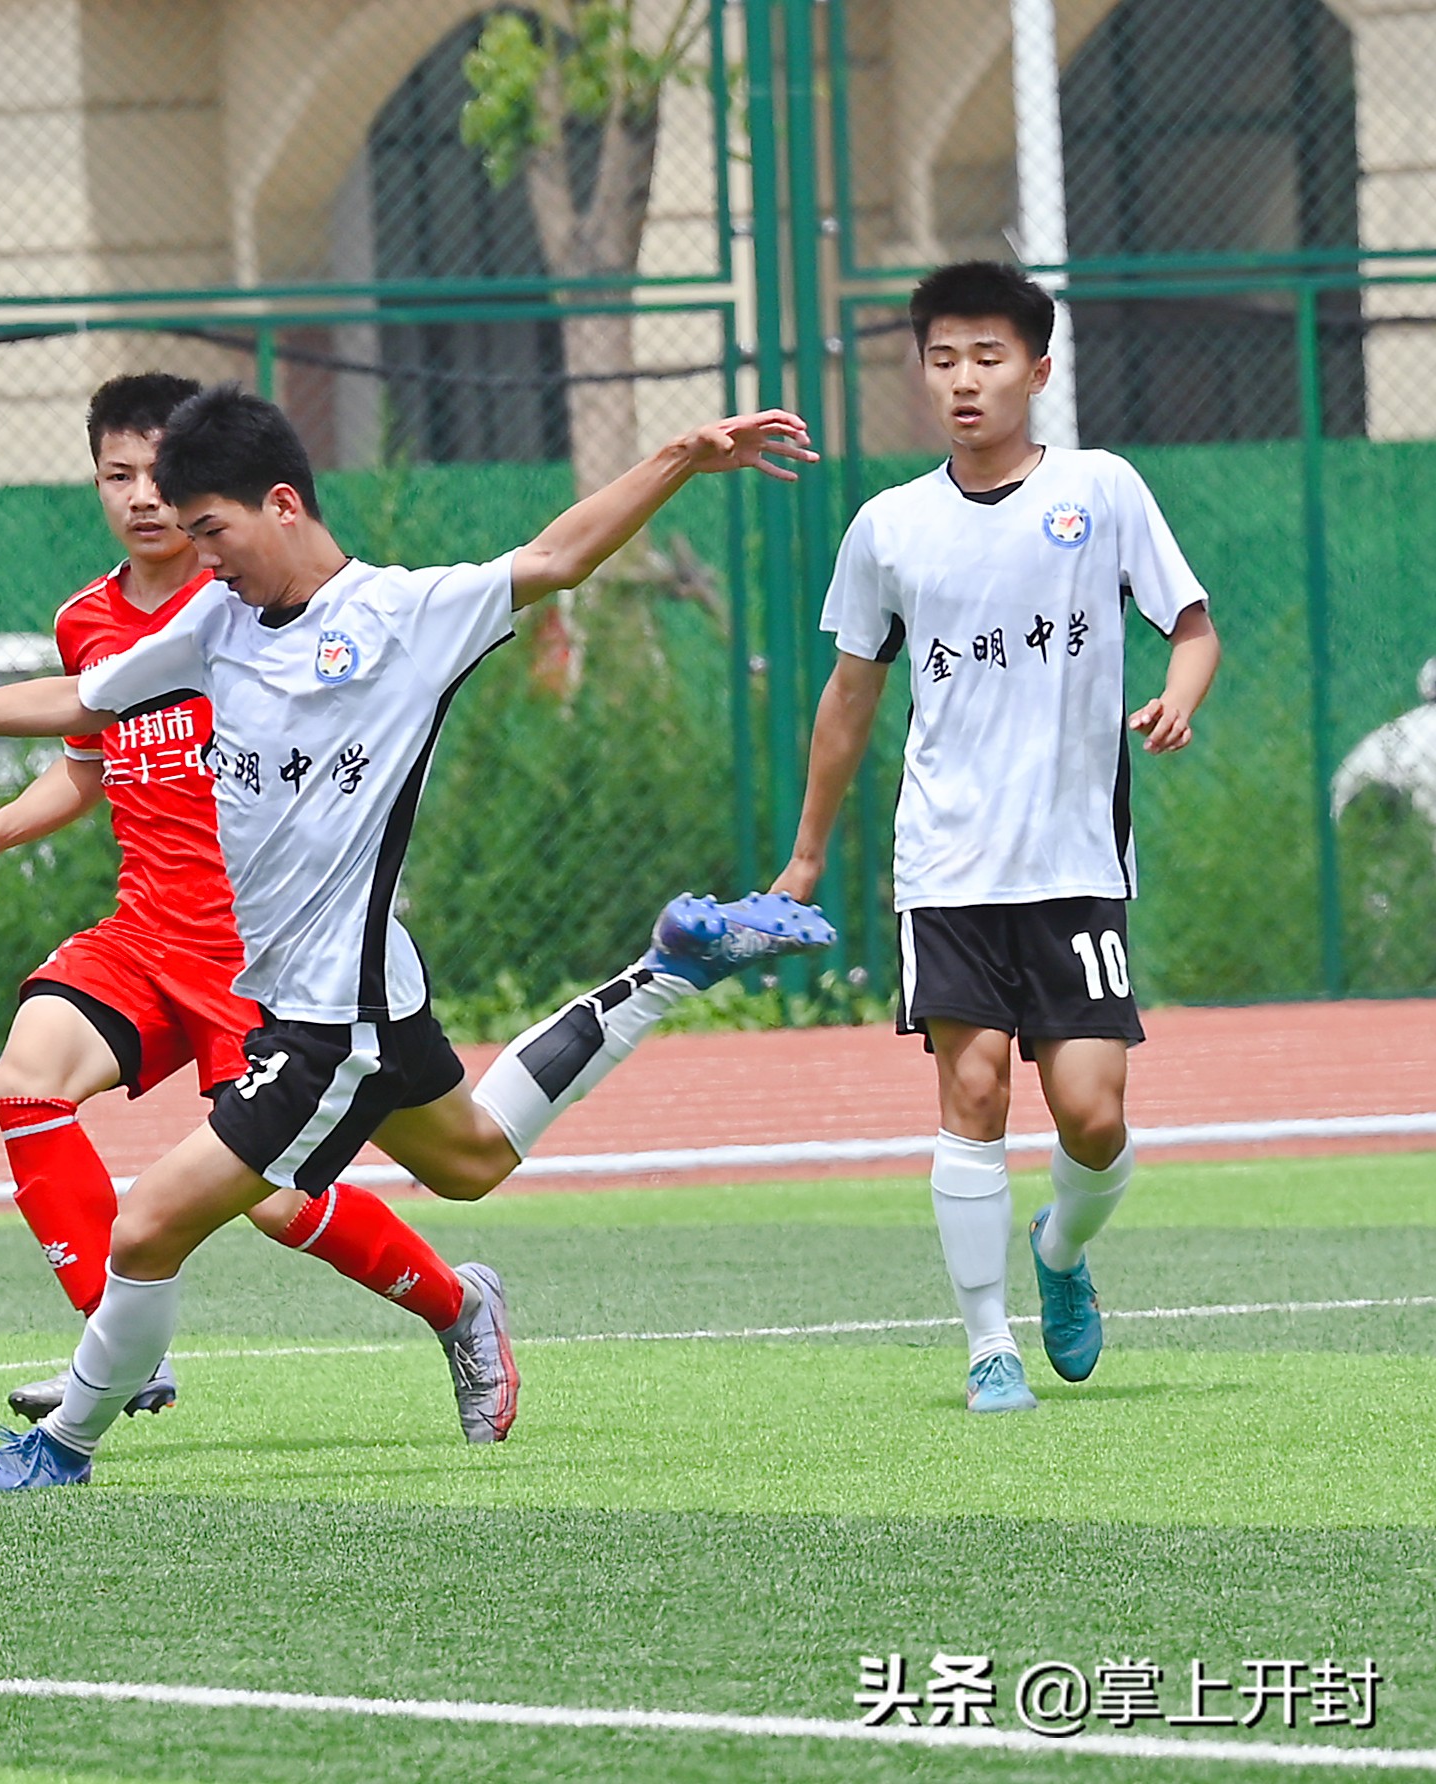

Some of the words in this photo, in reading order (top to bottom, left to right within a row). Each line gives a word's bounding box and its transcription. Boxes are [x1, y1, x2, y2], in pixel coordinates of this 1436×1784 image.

[921, 610, 1089, 683] 金明中学
[117, 706, 194, 751] 开封市
[1071, 929, 1130, 1001] 10
